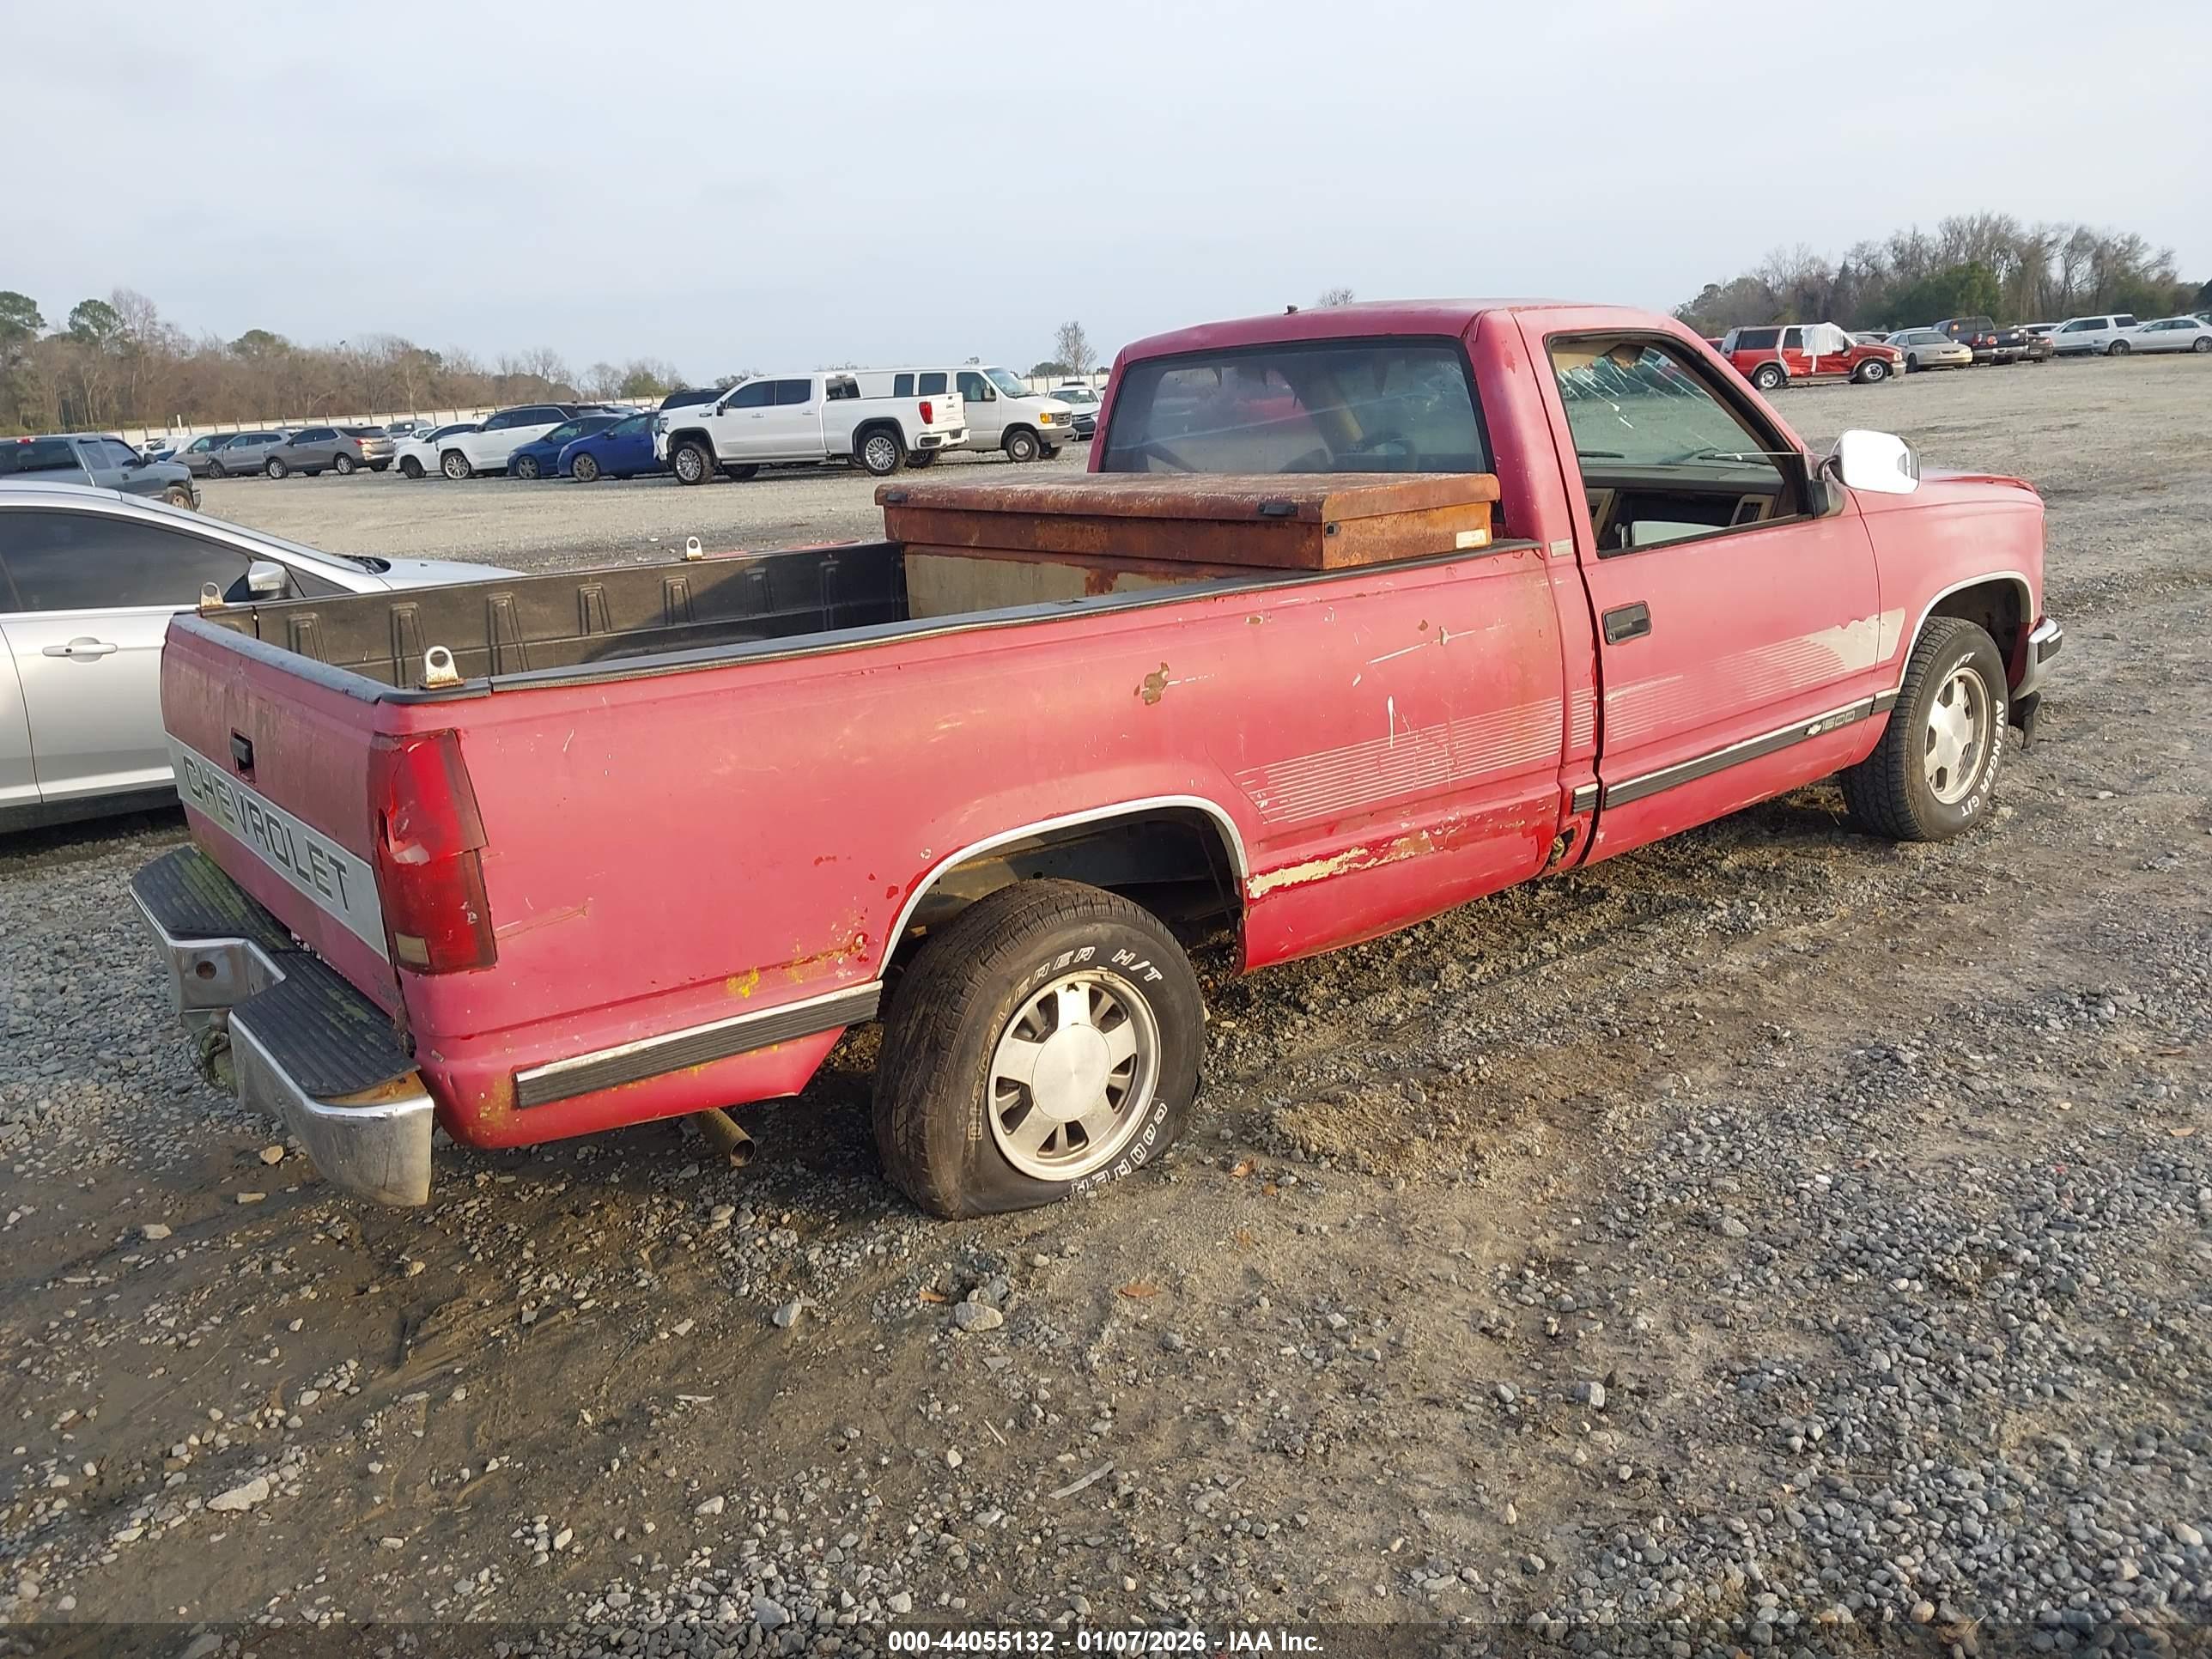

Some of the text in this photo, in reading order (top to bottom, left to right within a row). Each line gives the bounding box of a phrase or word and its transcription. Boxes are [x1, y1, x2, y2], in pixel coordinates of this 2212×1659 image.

[1960, 699, 2005, 817] AVENGER G/T
[183, 755, 349, 914] CHEVROLET
[1111, 948, 1163, 981] H/T
